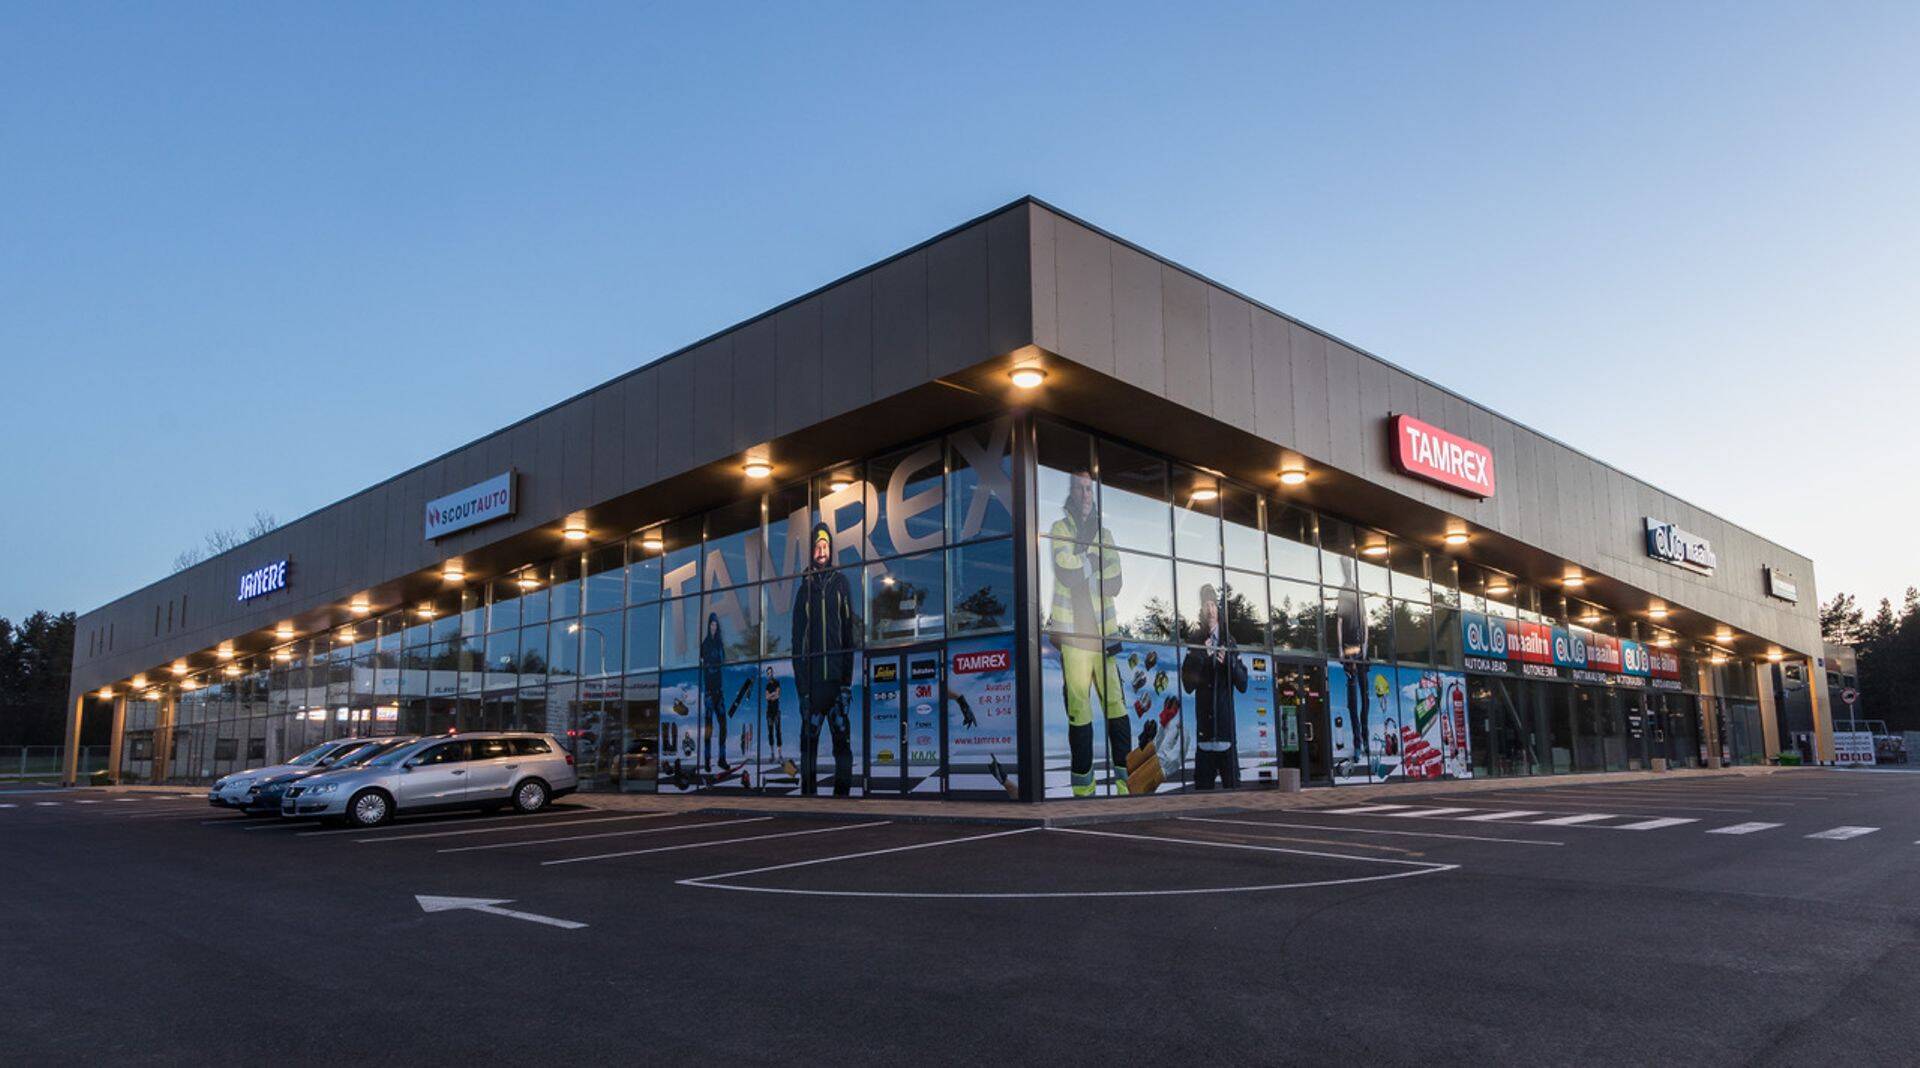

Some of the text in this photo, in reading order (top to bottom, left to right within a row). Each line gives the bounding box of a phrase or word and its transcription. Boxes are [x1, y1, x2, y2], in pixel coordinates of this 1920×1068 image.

[1406, 425, 1488, 487] TAMREX
[441, 489, 508, 525] SCOUTAUTO
[663, 423, 1013, 656] TAMREX
[956, 653, 1006, 670] TAMREX
[915, 685, 932, 698] 3M
